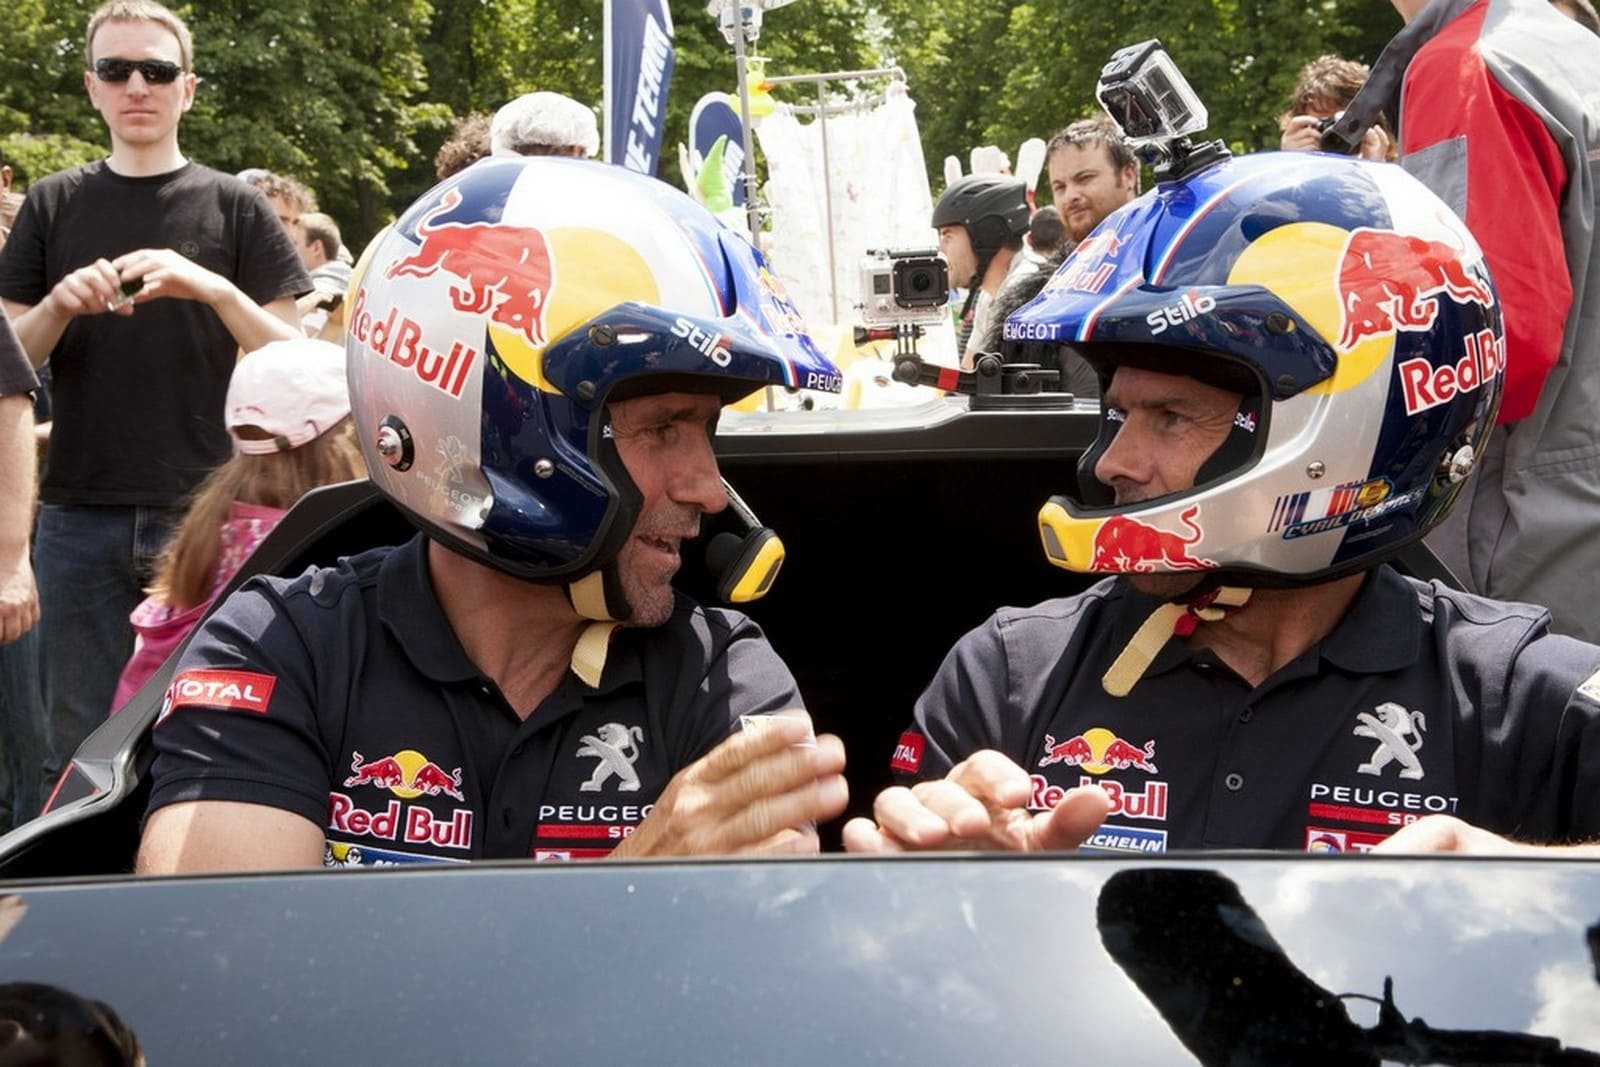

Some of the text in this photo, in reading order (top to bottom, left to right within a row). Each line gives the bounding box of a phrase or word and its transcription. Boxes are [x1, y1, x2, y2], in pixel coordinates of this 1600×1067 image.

[1146, 293, 1216, 335] Stilo
[350, 288, 477, 400] Red Bull
[670, 317, 732, 368] Stilo
[1398, 333, 1480, 416] Red
[328, 791, 473, 849] Red Bull
[1026, 774, 1168, 821] Re Bull
[1311, 783, 1459, 812] PEUGEOT
[1086, 834, 1163, 852] ICHELIN
